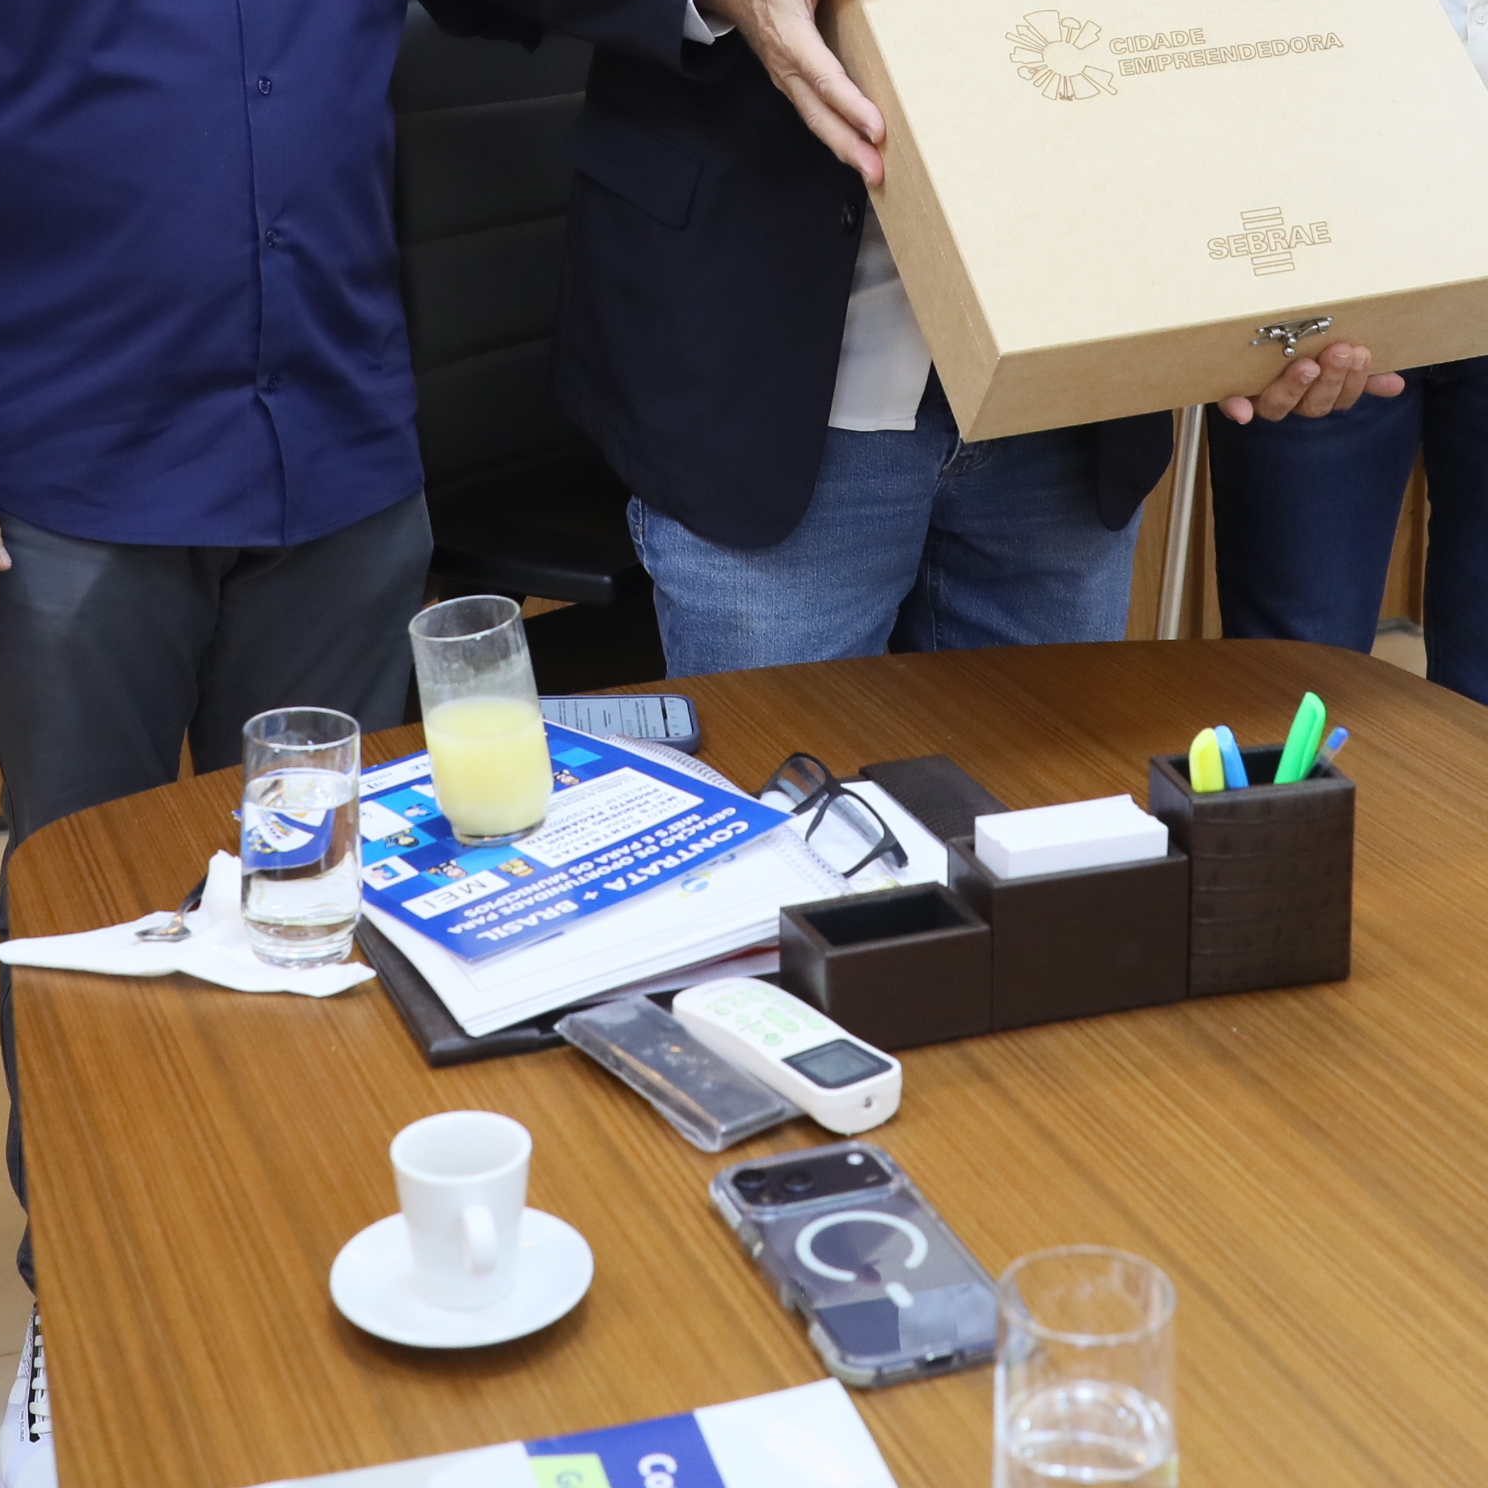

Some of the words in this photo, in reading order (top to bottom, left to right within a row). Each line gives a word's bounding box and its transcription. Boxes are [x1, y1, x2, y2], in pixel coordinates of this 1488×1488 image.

[1109, 27, 1206, 55] CIDADE
[1117, 31, 1344, 77] EMPREENDEDORA
[1207, 221, 1331, 260] SEBRAE
[525, 810, 606, 845] PAGAMENTO
[550, 819, 642, 859] CONTRATAR
[641, 835, 655, 844] E
[660, 807, 737, 847] GERAÇÃO
[568, 861, 594, 875] OS
[593, 841, 642, 864] PARA
[603, 820, 749, 892] CONTRATA
[633, 844, 660, 859] DE
[423, 879, 488, 909] MEI
[463, 871, 569, 919] MUNICÍPIOS
[498, 855, 635, 916] OPORTUNIDADE
[447, 911, 499, 934] PARA
[476, 899, 579, 941] BRASIL
